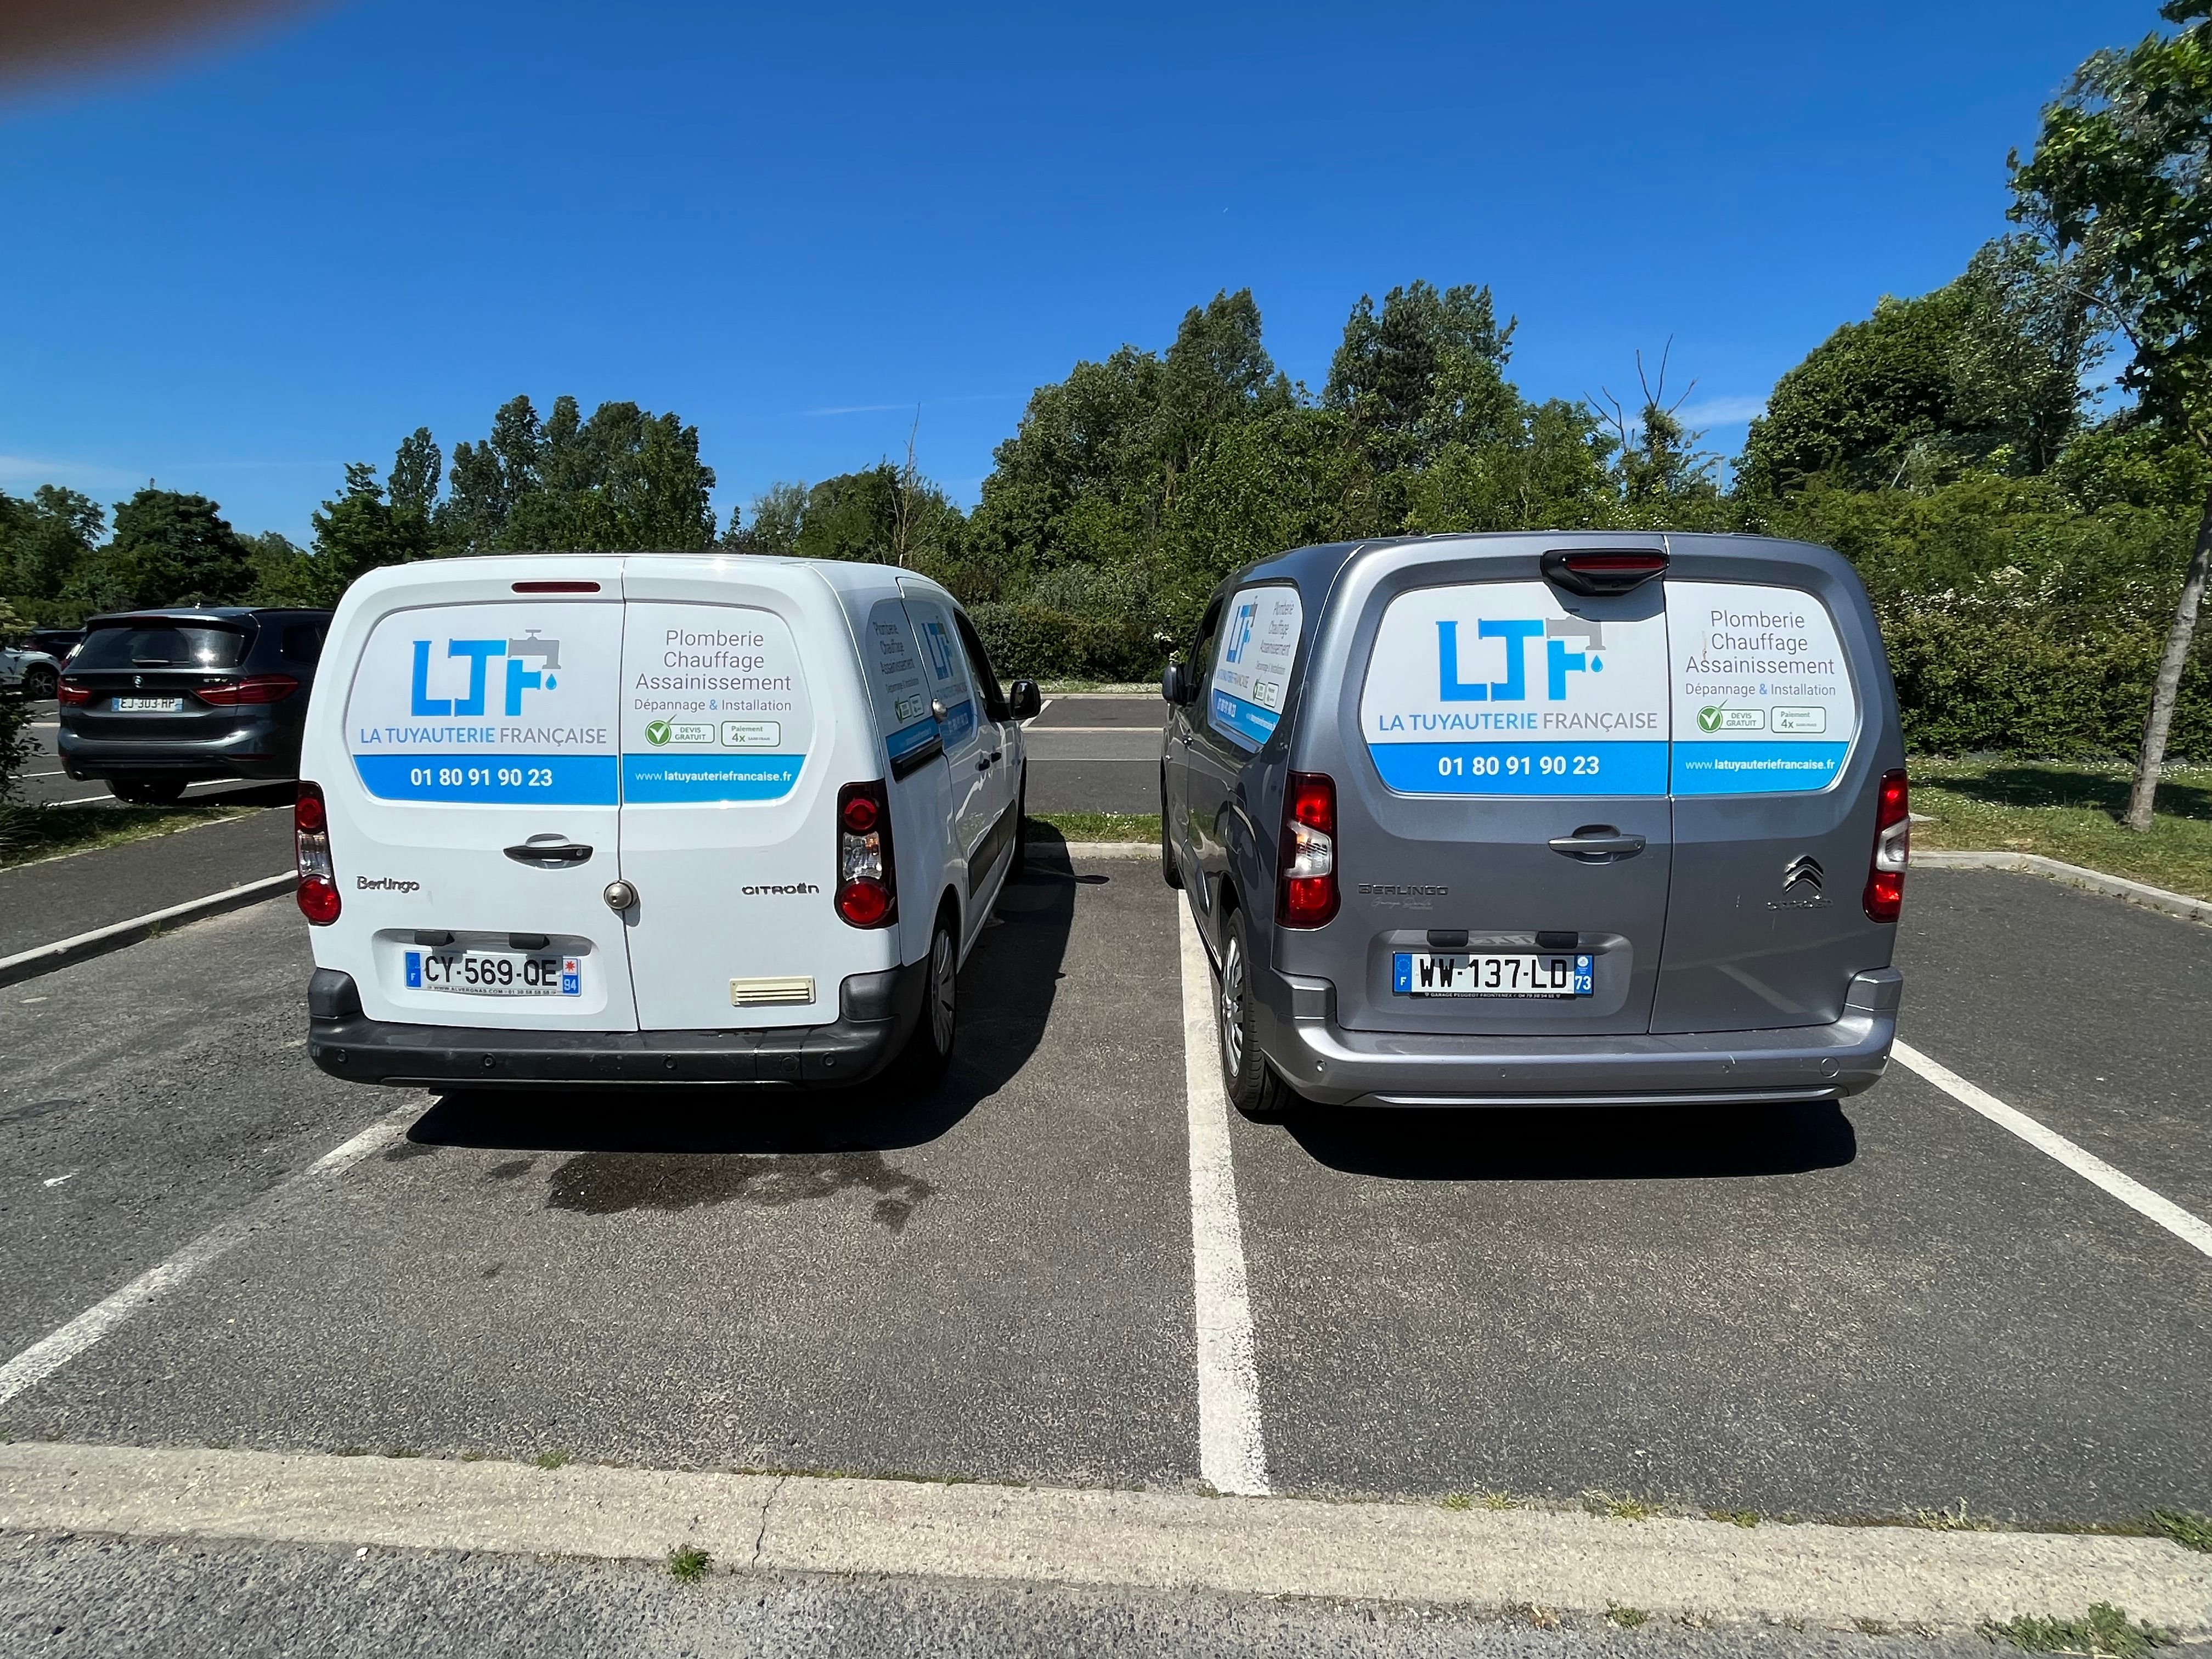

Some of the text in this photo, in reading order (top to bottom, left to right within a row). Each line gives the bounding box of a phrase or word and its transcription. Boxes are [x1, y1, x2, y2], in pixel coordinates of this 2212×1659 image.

[1711, 610, 1805, 629] Plomberie
[665, 629, 764, 647] Plomberie
[1711, 633, 1808, 655] Chauffage
[663, 651, 764, 673] Chauffage
[1435, 615, 1607, 702] LTF
[1685, 656, 1835, 675] Assainissement
[410, 636, 562, 718] LTF
[635, 673, 792, 691] Assainissement
[1685, 683, 1836, 697] Dépannage & Installation
[634, 698, 792, 713] Dépannage & Installation
[1379, 712, 1658, 732] LA TUYAUTERIE FRANÇAISE
[1781, 719, 1794, 729] 4x
[360, 727, 607, 747] LA TUYAUTERIE FRANÇAISE
[732, 733, 746, 743] 4x
[1438, 756, 1600, 776] 01 80 91 90 23
[1685, 759, 1835, 772] www.latuyauteriefrancaise.fr
[410, 768, 553, 787] 01 80 91 90 23
[635, 771, 792, 783] www.latuyauteriefrancaise.fr
[357, 876, 420, 894] Berlingo
[1358, 883, 1449, 895] BERLINGO
[410, 956, 558, 986] F CY-569-QE
[1400, 958, 1567, 989] F WW-137-LD
[563, 979, 577, 991] 94
[1575, 975, 1592, 990] 73
